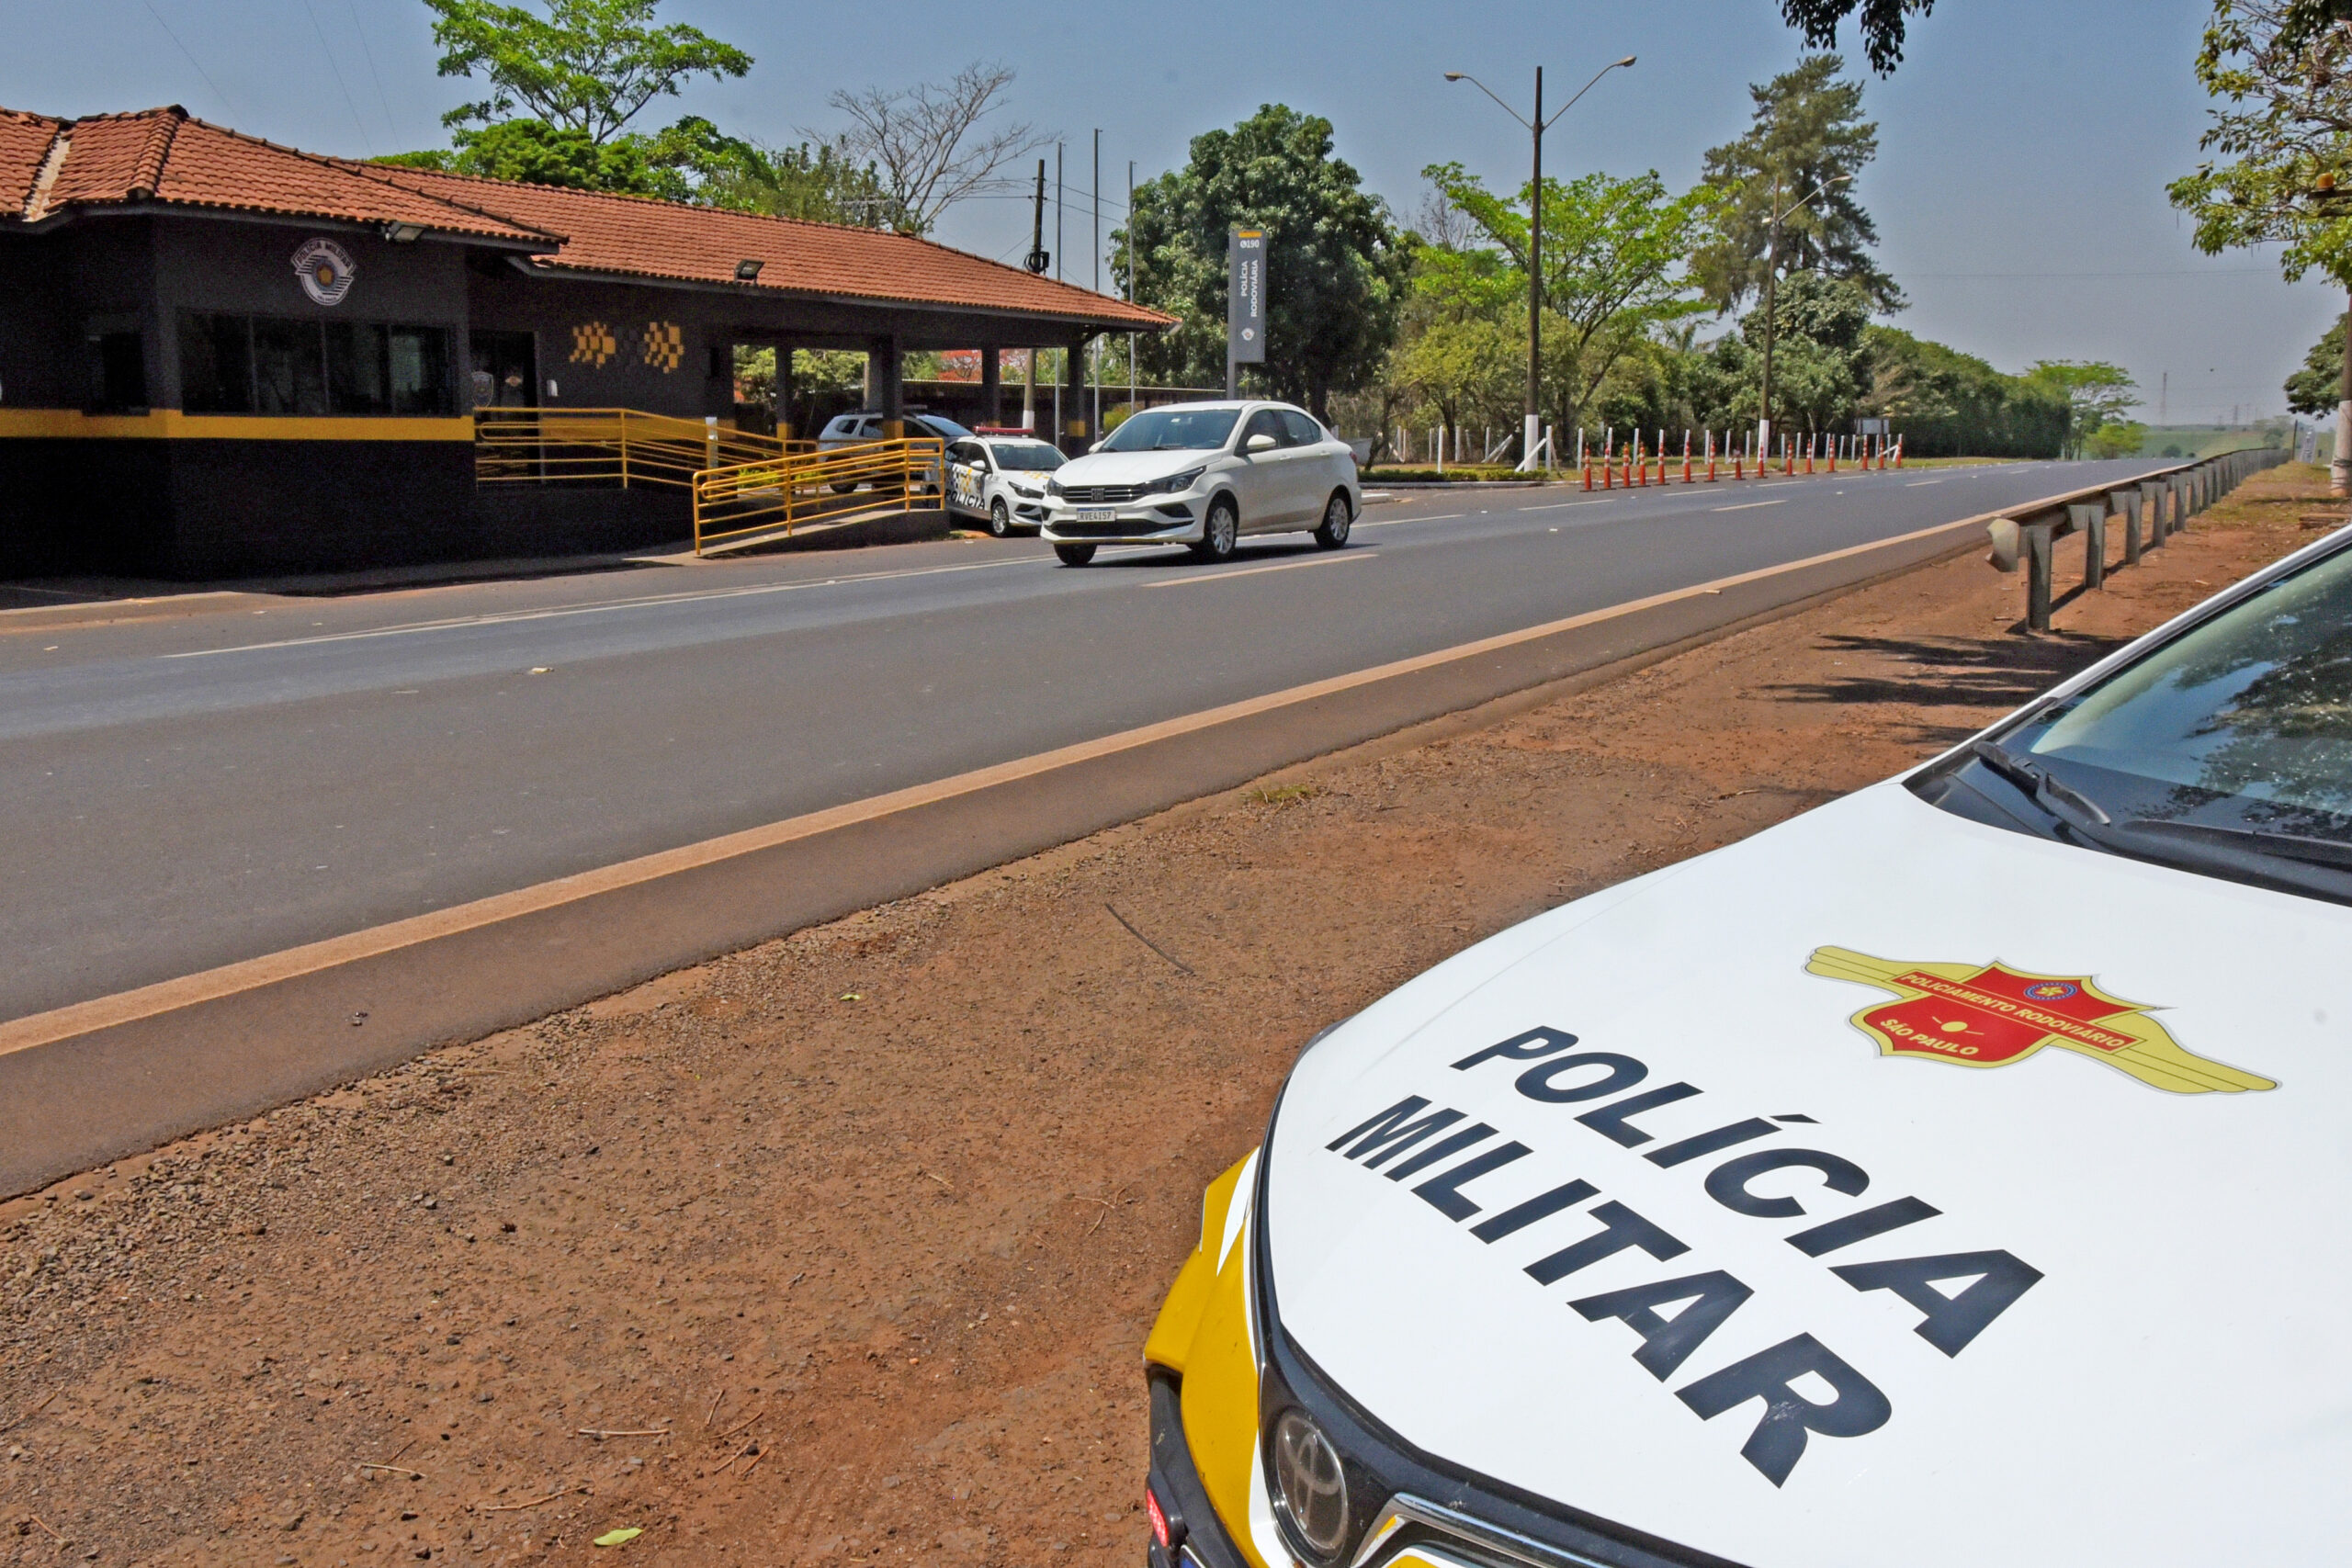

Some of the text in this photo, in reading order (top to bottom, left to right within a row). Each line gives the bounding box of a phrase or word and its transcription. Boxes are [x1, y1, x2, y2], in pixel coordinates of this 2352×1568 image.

[1246, 240, 1260, 248] 190
[1239, 260, 1248, 297] POLÍCIA
[1250, 259, 1258, 317] RODOVIÁRIA
[1900, 974, 2126, 1048] POLICIAMENTO RODOVIÁRIO
[1908, 1031, 1979, 1056] PAULO
[1451, 1026, 2044, 1358] POLÍCIA
[1326, 1096, 1891, 1488] MILITAR
